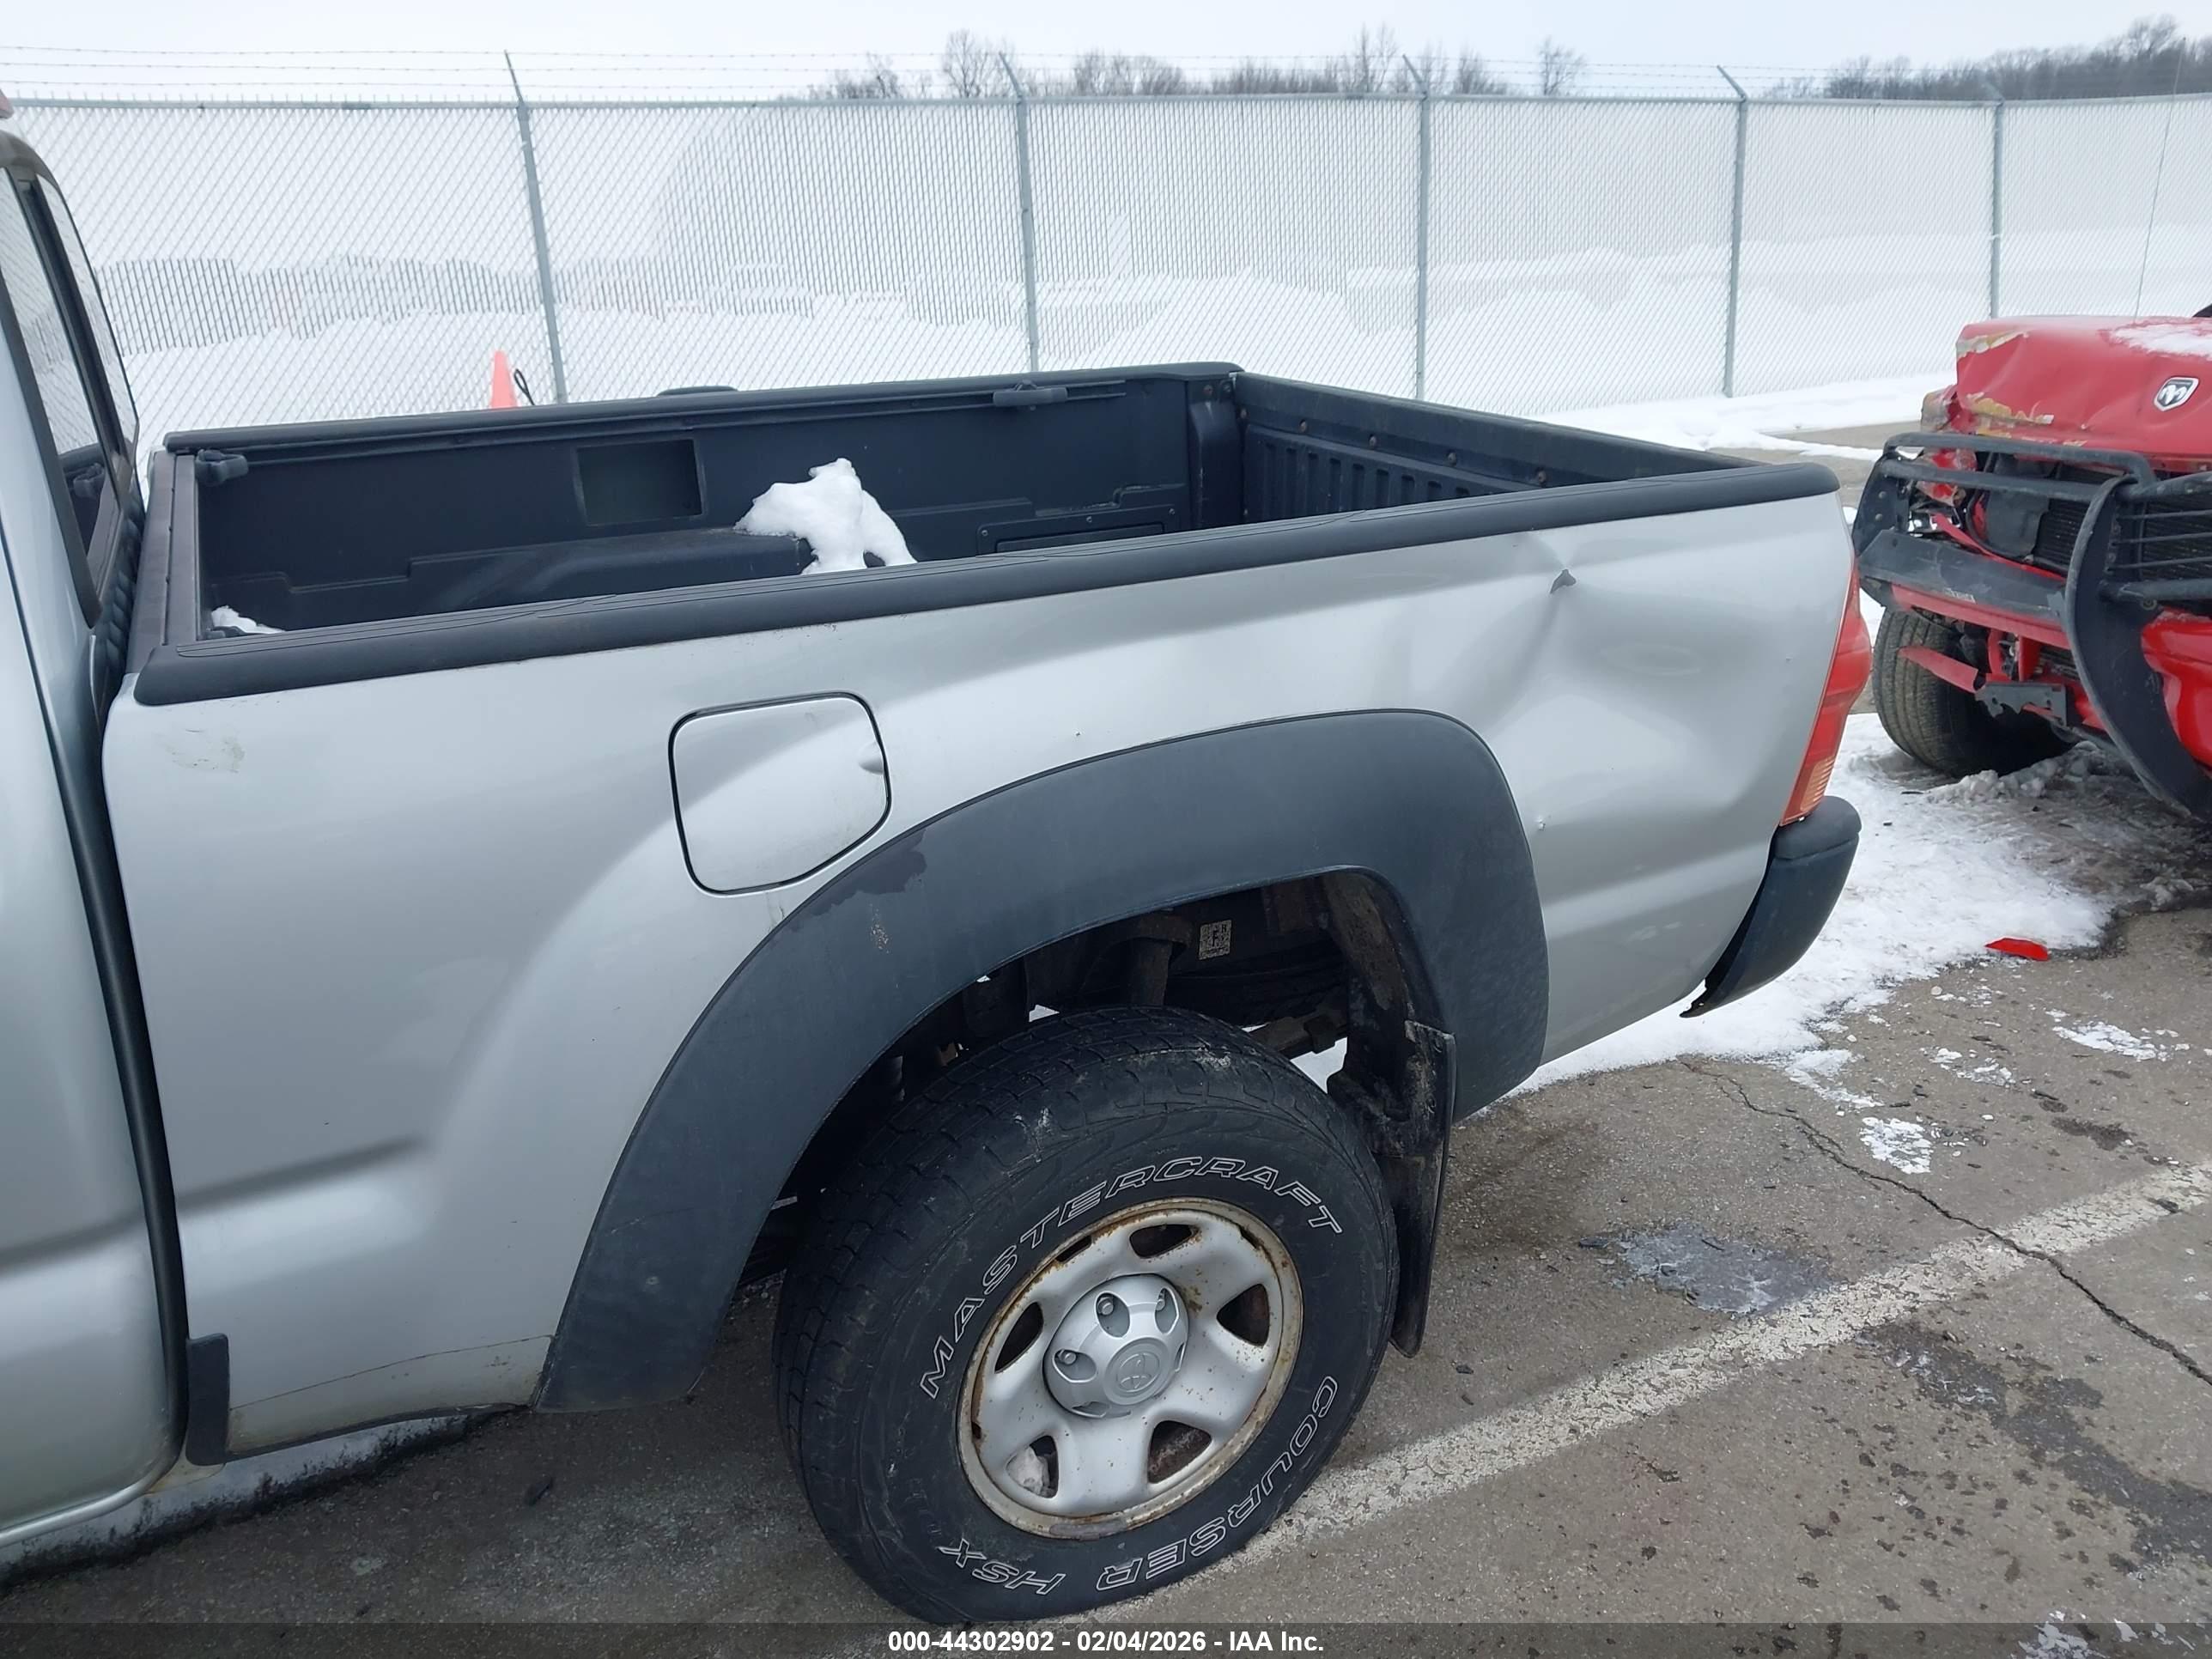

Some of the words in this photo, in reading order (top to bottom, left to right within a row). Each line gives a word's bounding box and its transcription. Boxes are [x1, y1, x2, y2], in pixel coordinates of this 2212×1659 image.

[920, 1157, 1342, 1399] MASTERCRAFT
[939, 1538, 1066, 1595] HSX
[1095, 1376, 1340, 1591] COURSER
